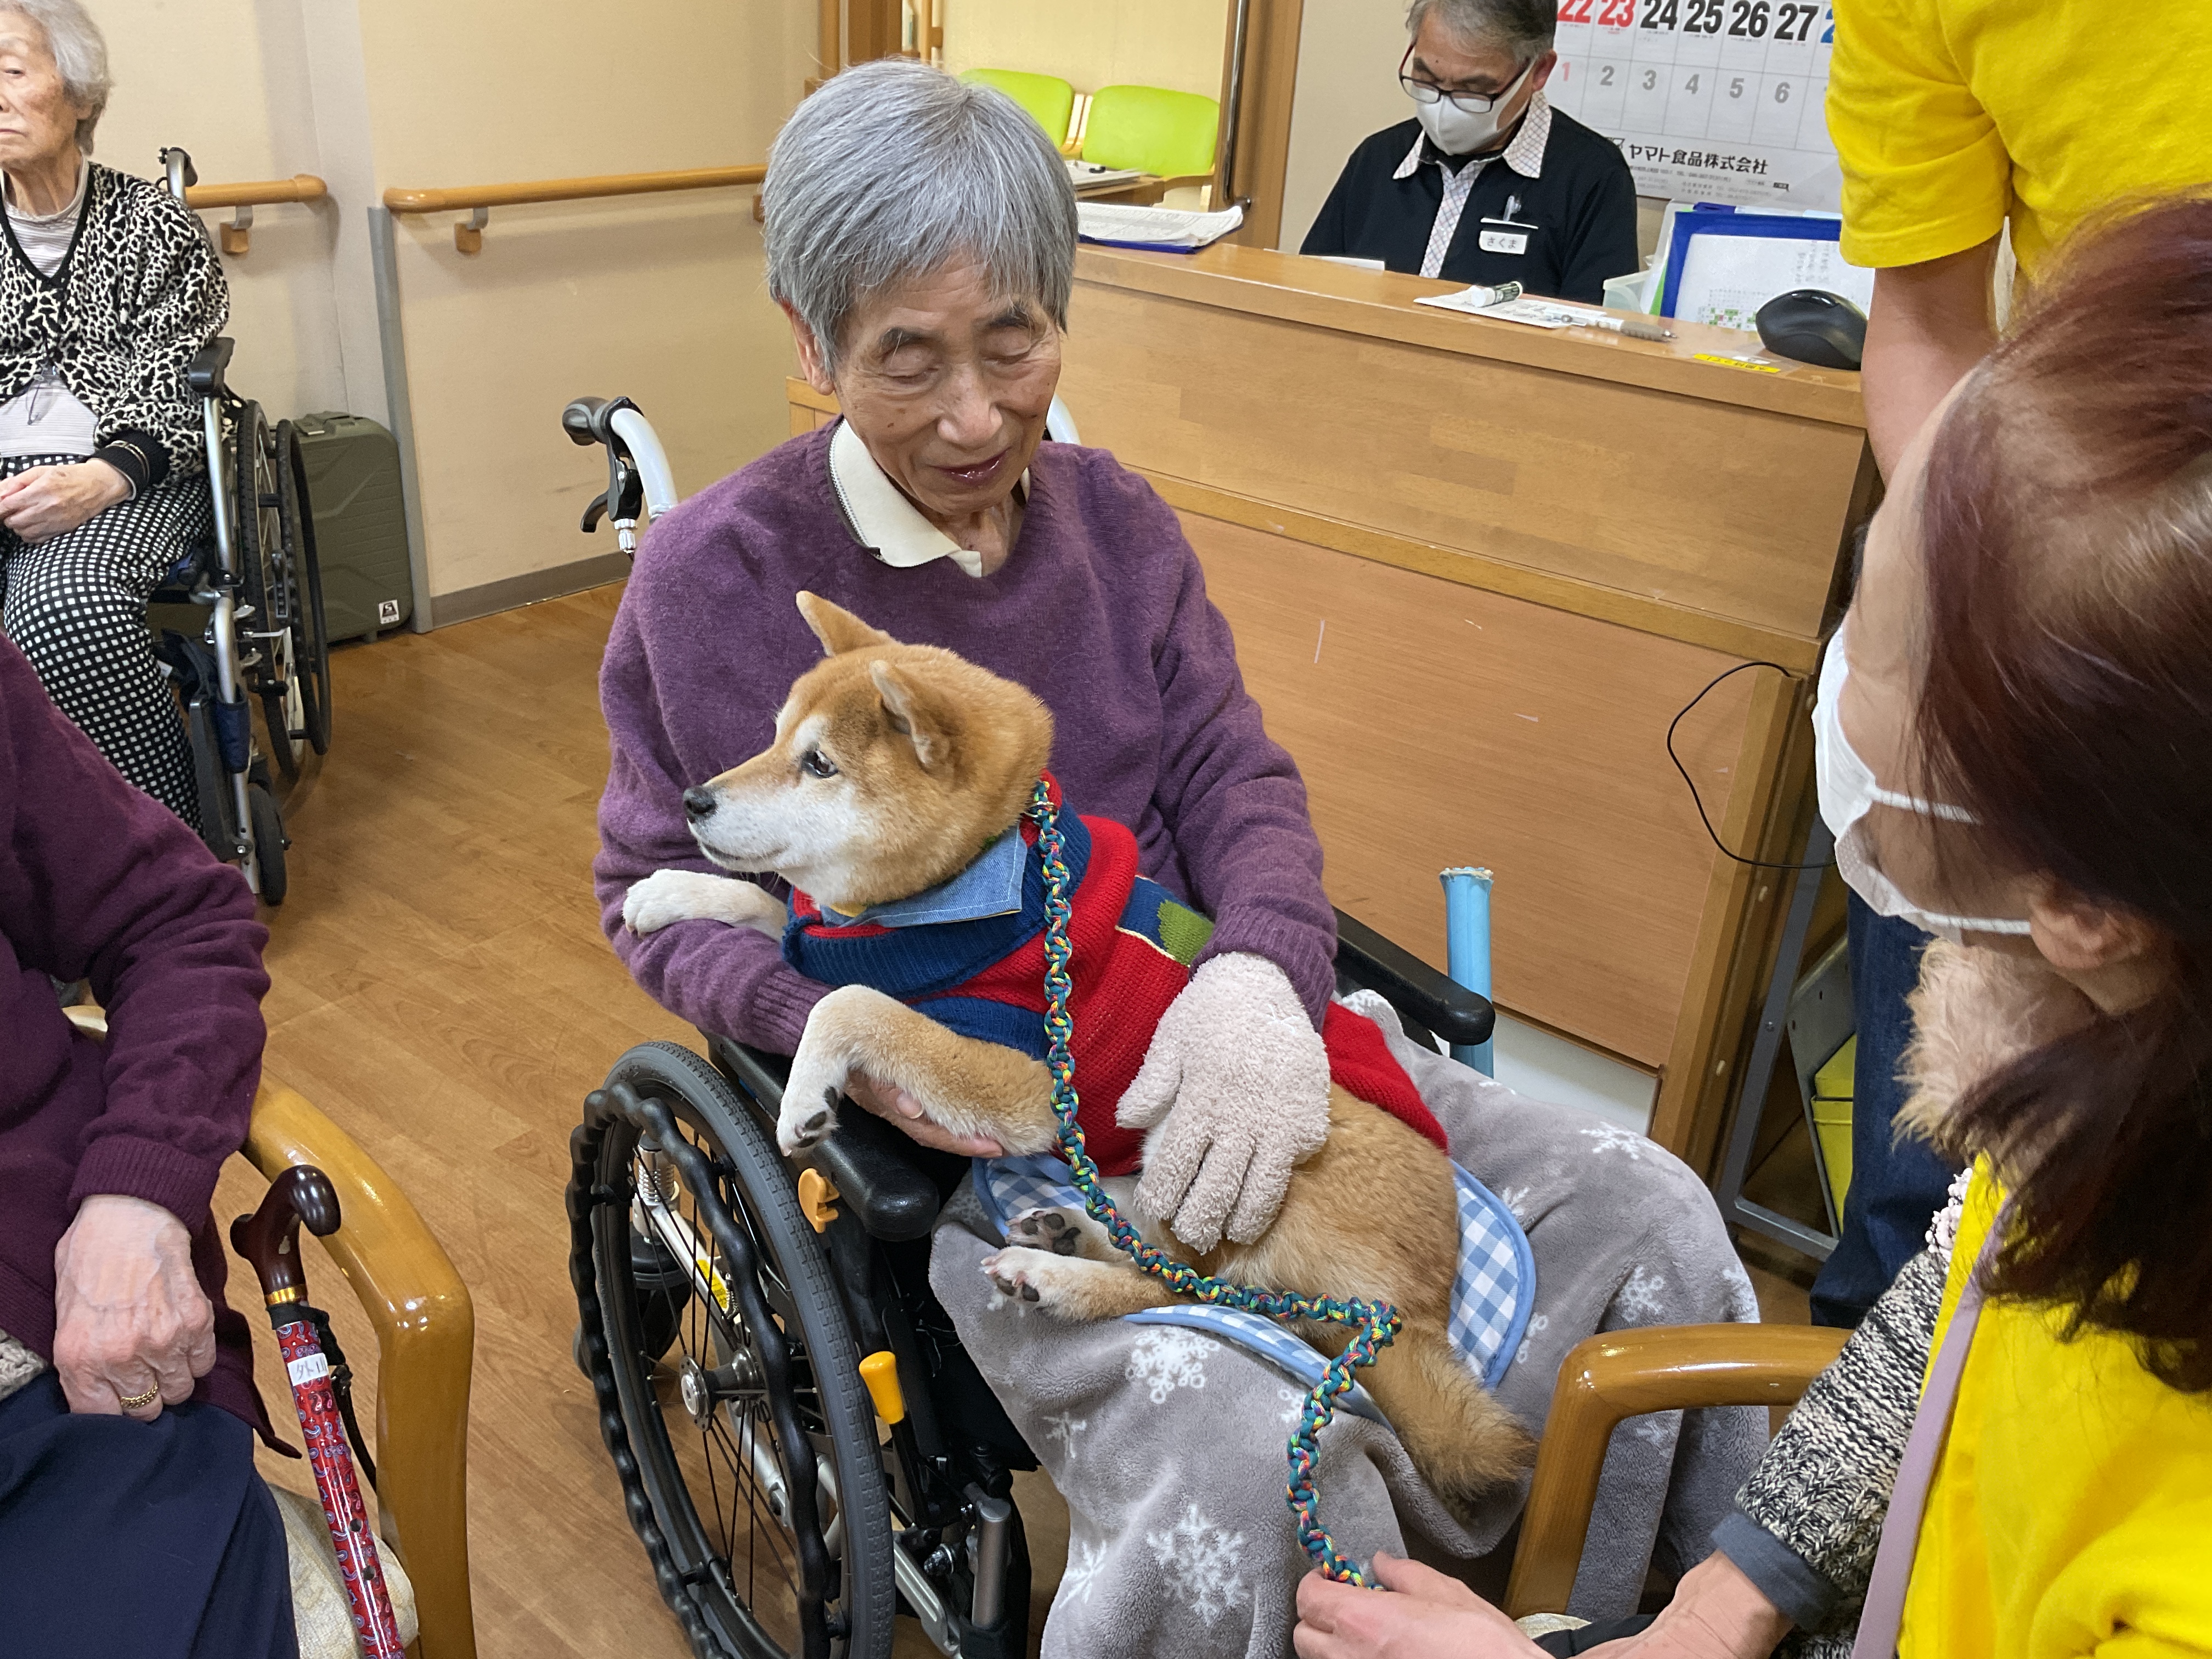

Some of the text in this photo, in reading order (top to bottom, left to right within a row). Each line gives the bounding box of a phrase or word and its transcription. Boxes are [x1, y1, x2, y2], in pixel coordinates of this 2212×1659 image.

[1598, 0, 1637, 27] 23
[1640, 0, 1678, 31] 24
[1683, 0, 1725, 33] 25
[1728, 0, 1770, 38] 26
[1774, 3, 1820, 41] 27
[1820, 8, 1835, 43] 2
[1561, 62, 1791, 103] 1 2 3 4 5 6
[1629, 143, 1768, 175] ヤマト食品株式会社
[1487, 237, 1517, 249] さくま
